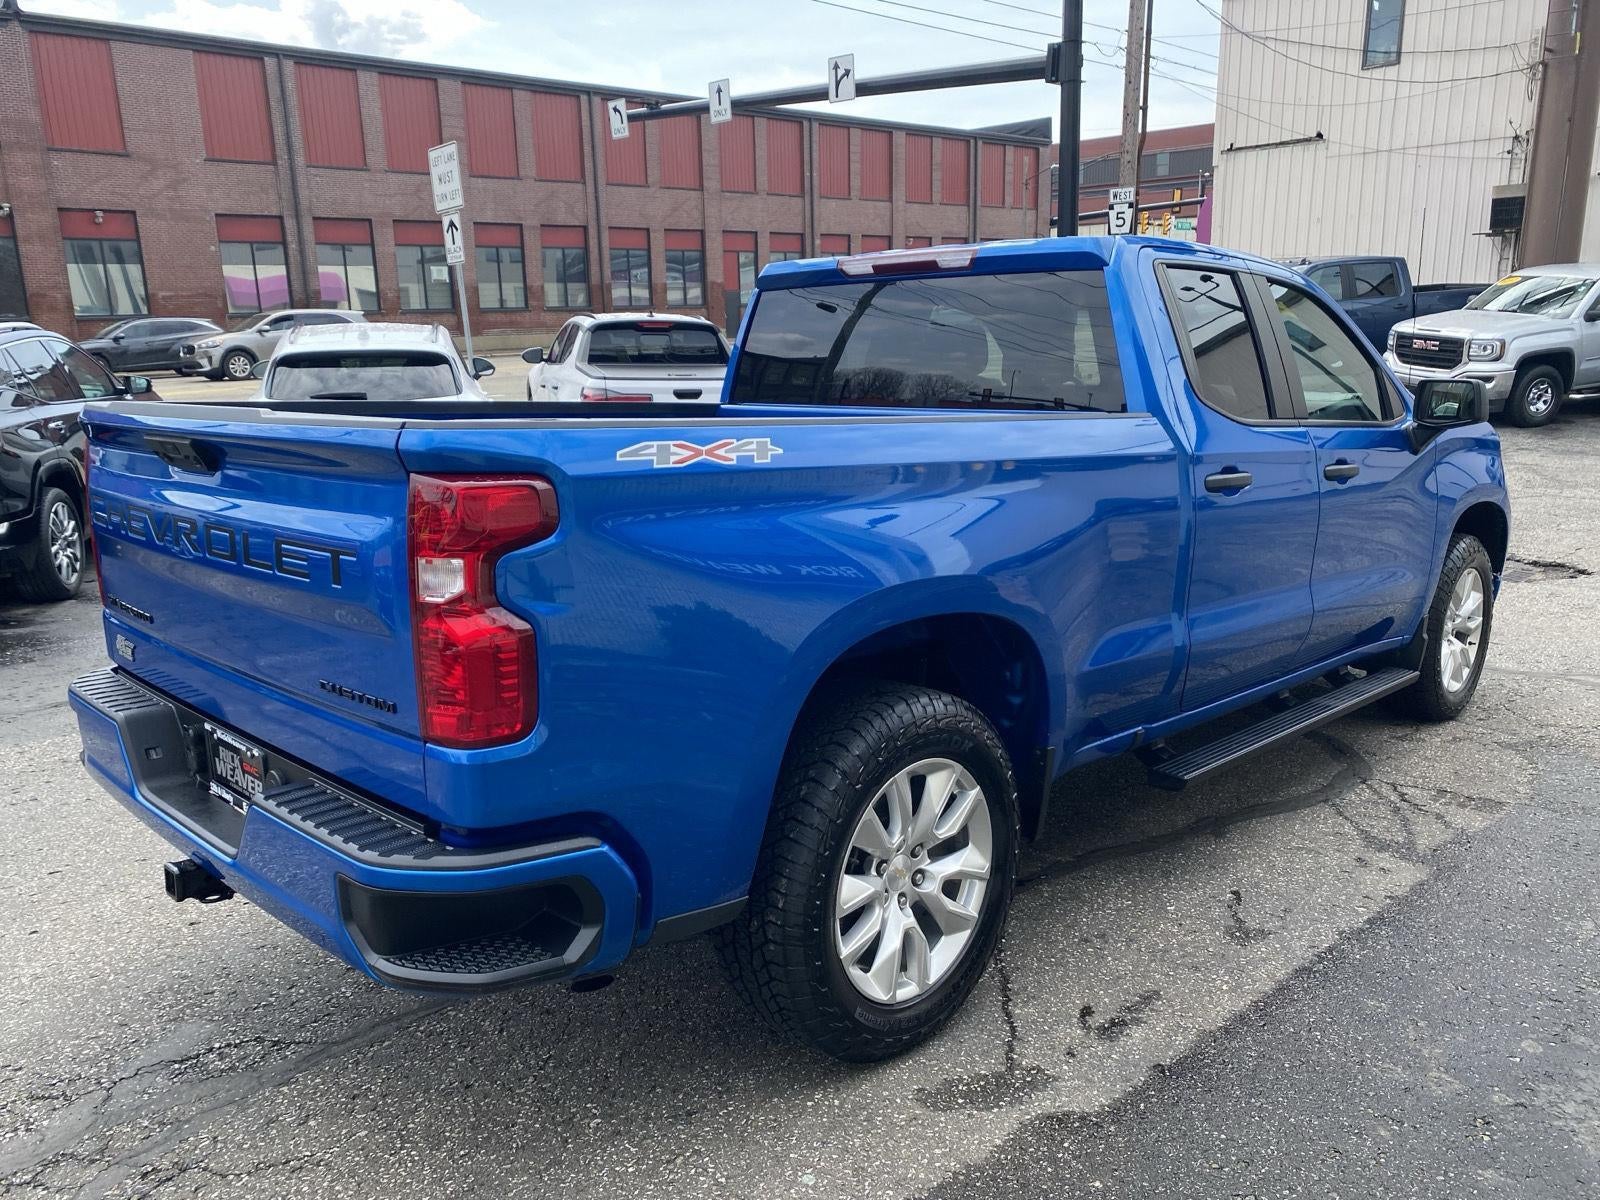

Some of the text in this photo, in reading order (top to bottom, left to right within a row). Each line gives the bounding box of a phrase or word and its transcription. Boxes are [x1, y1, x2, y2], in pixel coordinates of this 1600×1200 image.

[713, 108, 728, 118] ONLY
[613, 127, 626, 136] ONLY
[431, 150, 456, 168] LEFT LANE
[437, 170, 453, 185] MUST
[436, 189, 460, 204] TURN LEFT
[1112, 190, 1132, 200] WEST
[1115, 211, 1126, 228] 5
[447, 246, 462, 255] BLACK
[1412, 339, 1440, 350] GMC
[93, 496, 358, 590] CHEVROLET
[319, 679, 398, 714] CUSTOM
[219, 745, 241, 767] RICK
[214, 756, 263, 795] WEAVER
[242, 762, 260, 777] GMC
